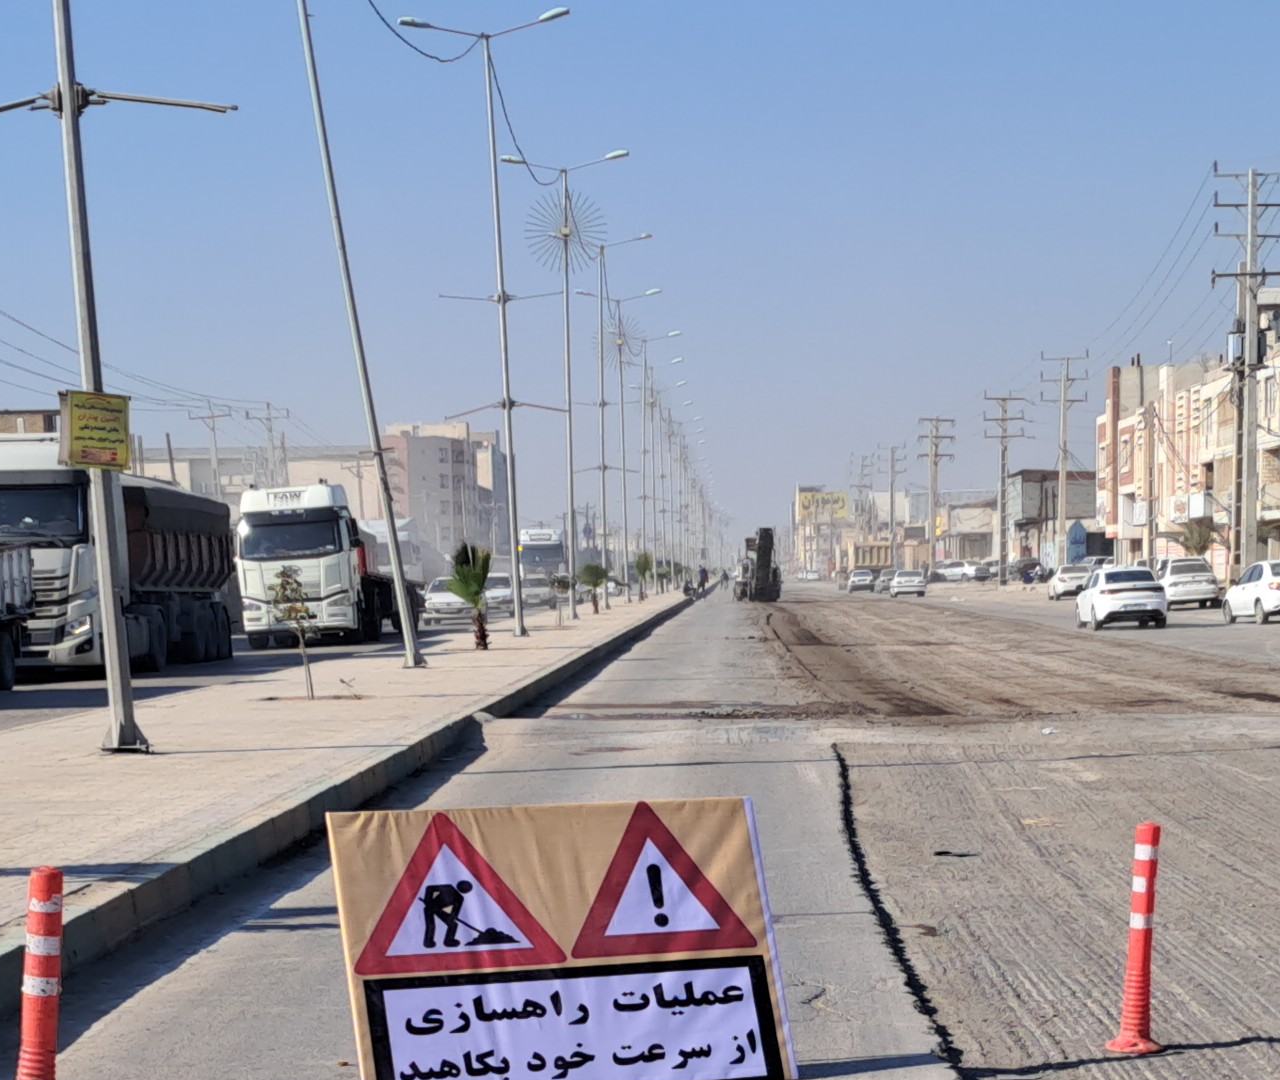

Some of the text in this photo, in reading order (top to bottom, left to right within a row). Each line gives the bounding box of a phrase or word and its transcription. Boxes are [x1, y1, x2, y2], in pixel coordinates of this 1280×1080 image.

[274, 492, 302, 500] FAW
[405, 980, 744, 1036] عملیات راهسازی
[527, 1042, 596, 1080] خود
[612, 1043, 713, 1070] سرعت
[729, 1029, 757, 1065] از
